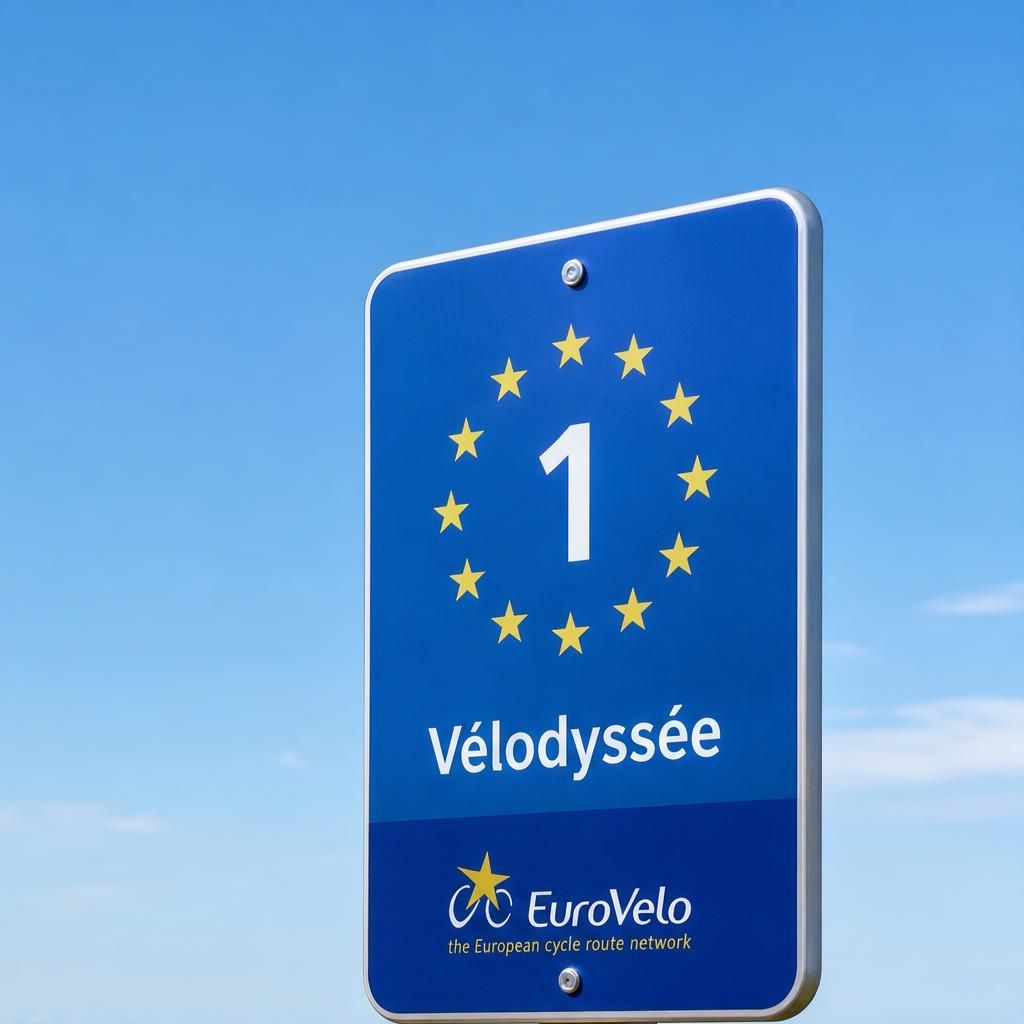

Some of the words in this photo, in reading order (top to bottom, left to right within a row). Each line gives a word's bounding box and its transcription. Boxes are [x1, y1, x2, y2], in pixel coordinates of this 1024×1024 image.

[538, 421, 591, 563] 1
[427, 703, 721, 782] Vélodyssée
[527, 885, 692, 928] EuroVelo
[448, 938, 470, 953] the
[474, 938, 540, 957] European
[544, 936, 581, 956] cycle
[585, 936, 625, 952] route
[630, 933, 692, 951] network
